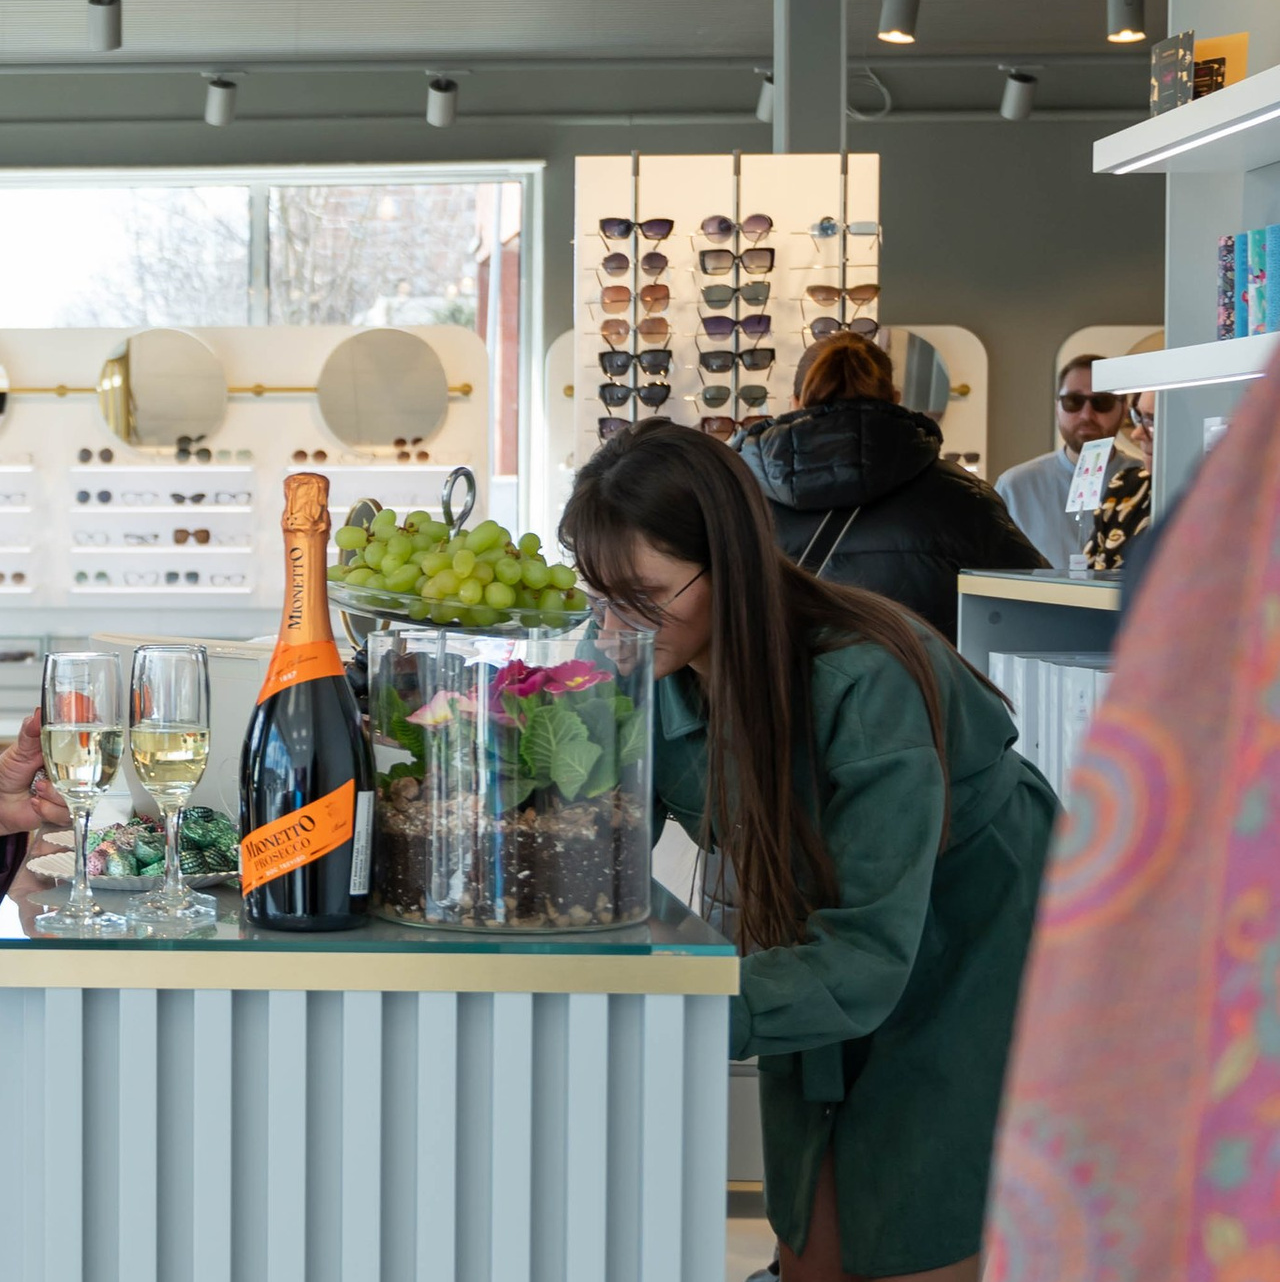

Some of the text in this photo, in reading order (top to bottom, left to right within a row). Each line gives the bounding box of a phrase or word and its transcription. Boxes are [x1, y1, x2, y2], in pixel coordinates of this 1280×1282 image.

[287, 547, 303, 630] MIONETTO
[245, 815, 316, 858] MIONETTO
[253, 837, 311, 871] PROSECCO
